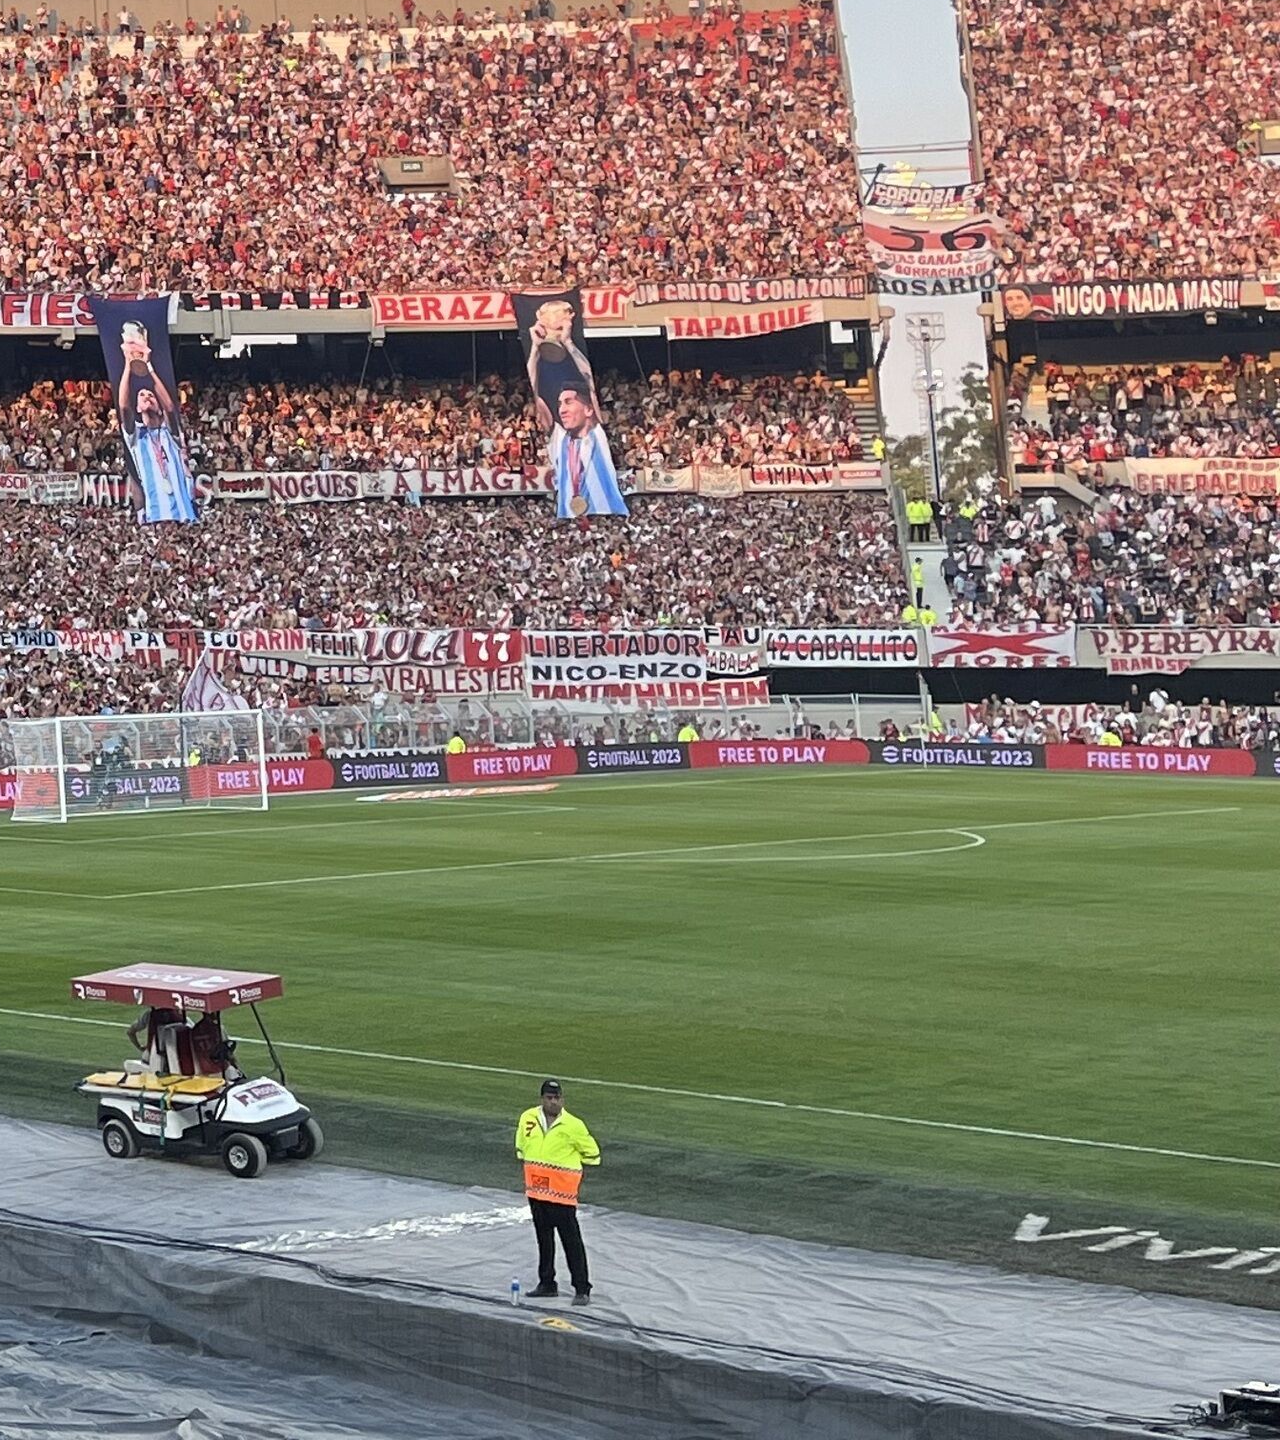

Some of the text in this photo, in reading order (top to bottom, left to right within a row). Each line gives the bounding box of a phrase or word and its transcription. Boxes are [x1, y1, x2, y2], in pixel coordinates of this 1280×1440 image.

[634, 283, 659, 306] UN
[663, 281, 722, 302] GRITO
[726, 281, 752, 304] DE
[871, 271, 996, 297] ROSARIO
[1052, 284, 1106, 316] HUGO
[1109, 284, 1123, 314] Y
[1127, 282, 1179, 314] NADA
[268, 472, 360, 503] NOGUES
[130, 631, 239, 648] PACHECO
[239, 629, 304, 651] GARIN
[469, 632, 513, 663] 77
[527, 633, 703, 660] LIBERTADOR
[766, 632, 918, 662] 42 CABALLITO
[240, 656, 309, 682] VILLA
[315, 665, 383, 684] ELISA
[531, 661, 702, 682] NICO-ENZO
[930, 654, 1073, 669] FLORES
[473, 754, 552, 776] FREE TO PLAY
[651, 747, 681, 765] 2023
[718, 745, 826, 764] FREE TO PLAY
[990, 748, 1034, 768] 2023
[1086, 750, 1211, 772] FREE TO PLAY
[218, 770, 254, 791] FREE
[275, 767, 306, 788] PLAY
[410, 760, 440, 779] 2023
[149, 775, 181, 794] 2023
